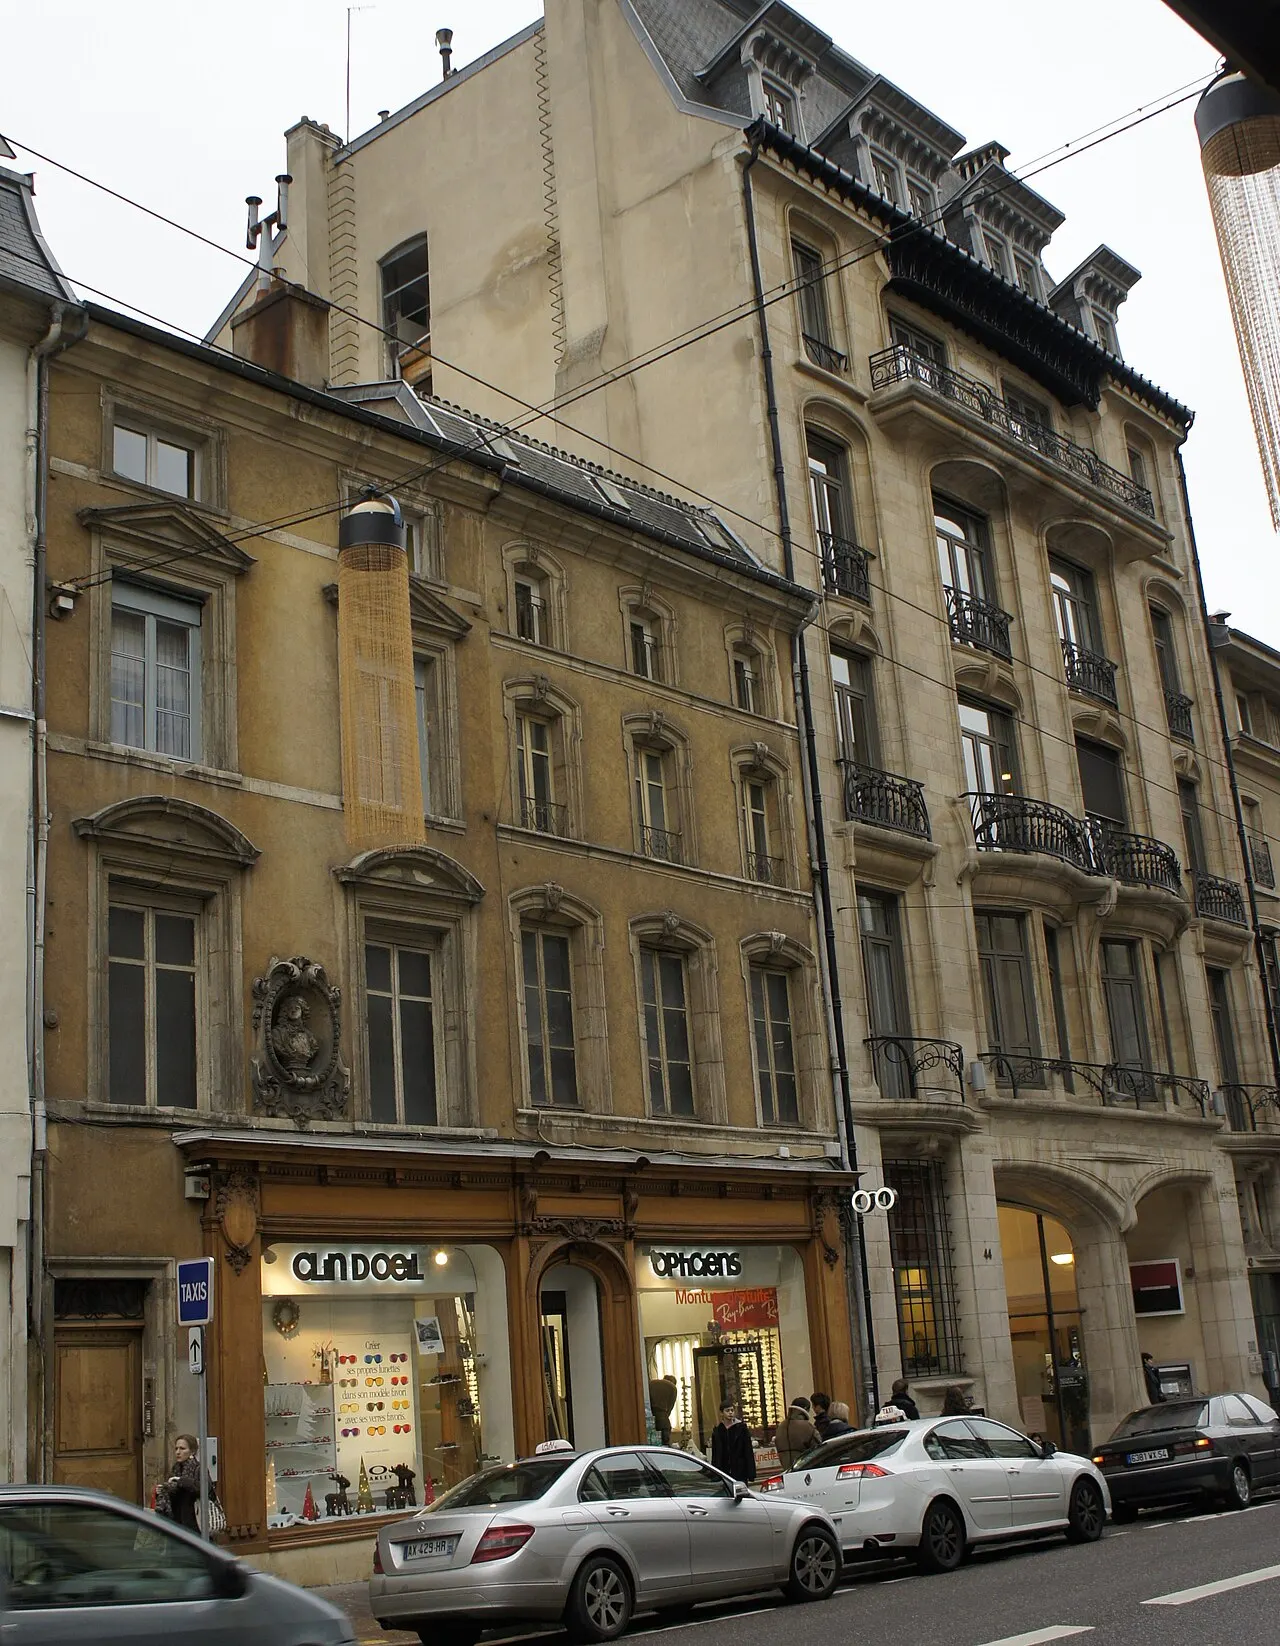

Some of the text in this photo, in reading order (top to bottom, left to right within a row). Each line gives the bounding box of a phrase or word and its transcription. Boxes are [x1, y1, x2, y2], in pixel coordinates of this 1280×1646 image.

[181, 1281, 207, 1302] TAXIS
[347, 1365, 401, 1377] ses propres lunettes
[342, 1390, 357, 1400] dans
[369, 1388, 390, 1398] modèle
[391, 1387, 407, 1396] favori
[344, 1416, 358, 1424] avec
[358, 1415, 368, 1423] ses
[368, 1414, 386, 1422] verres
